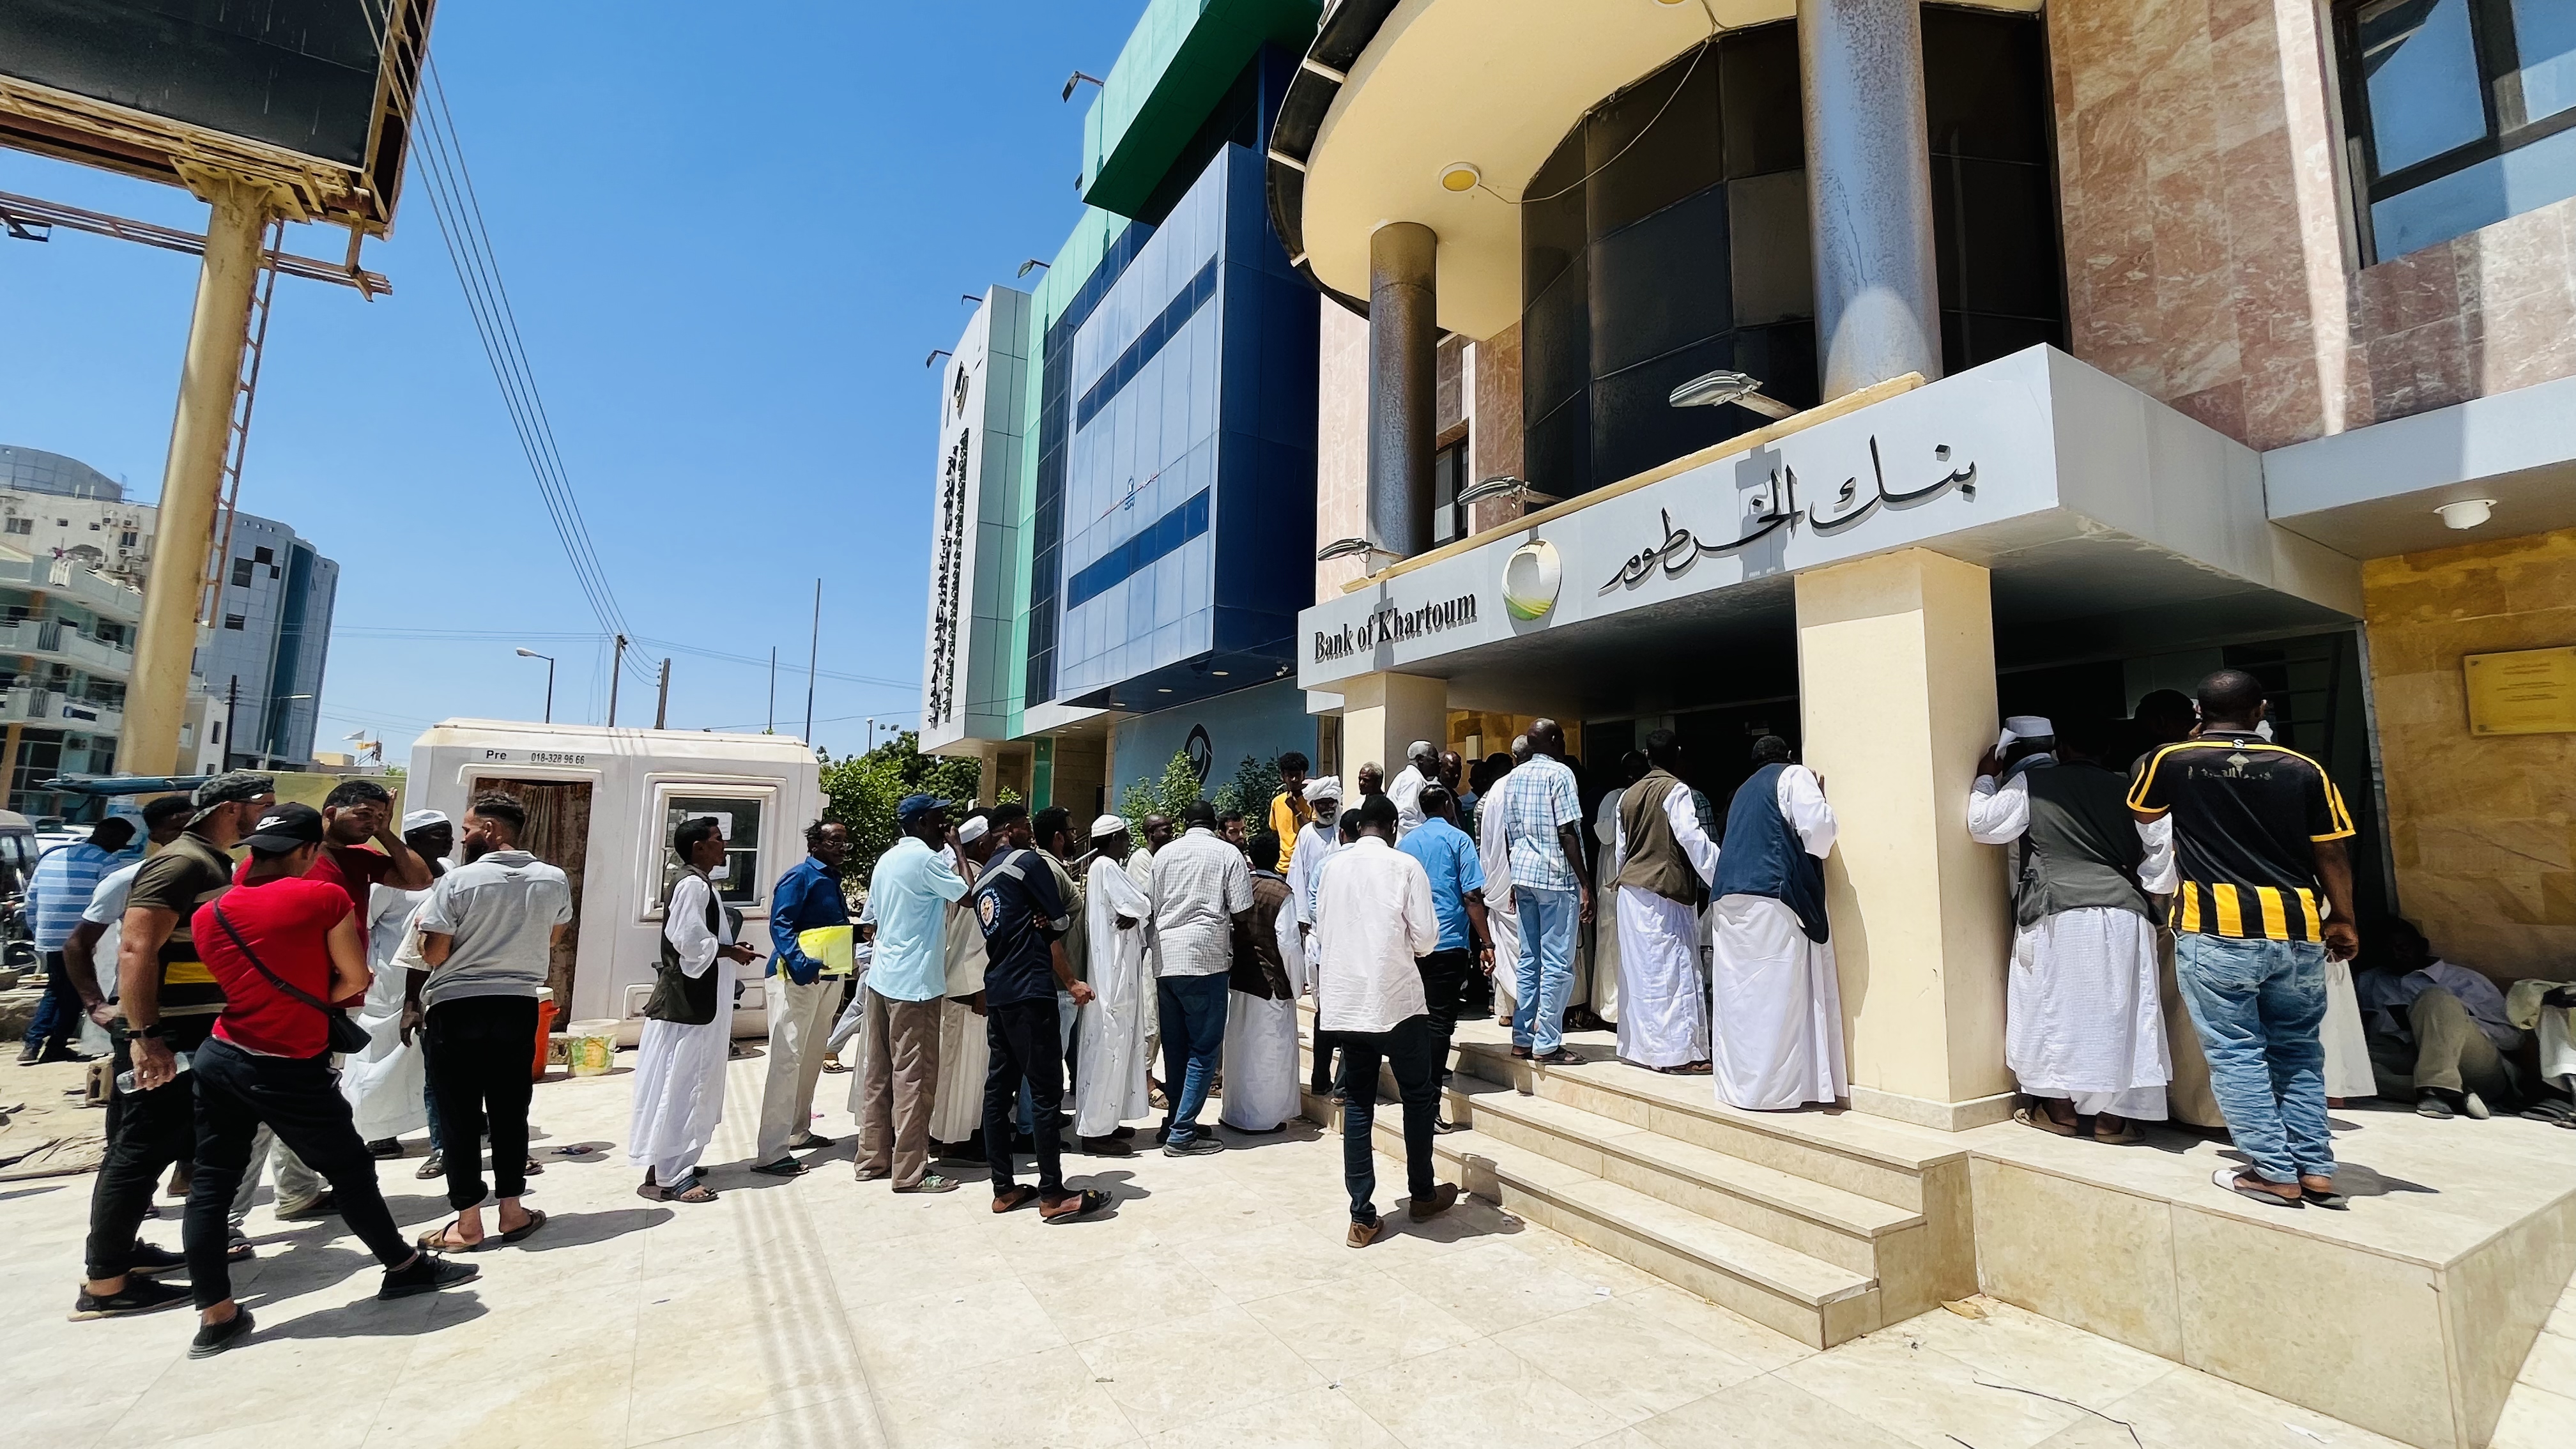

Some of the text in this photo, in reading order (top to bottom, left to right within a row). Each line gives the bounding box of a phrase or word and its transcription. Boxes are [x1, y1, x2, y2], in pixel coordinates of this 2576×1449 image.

[1597, 434, 1976, 594] بنك الخرطوم
[1314, 593, 1477, 662] Bank of Khartoum
[486, 750, 507, 760] Pre
